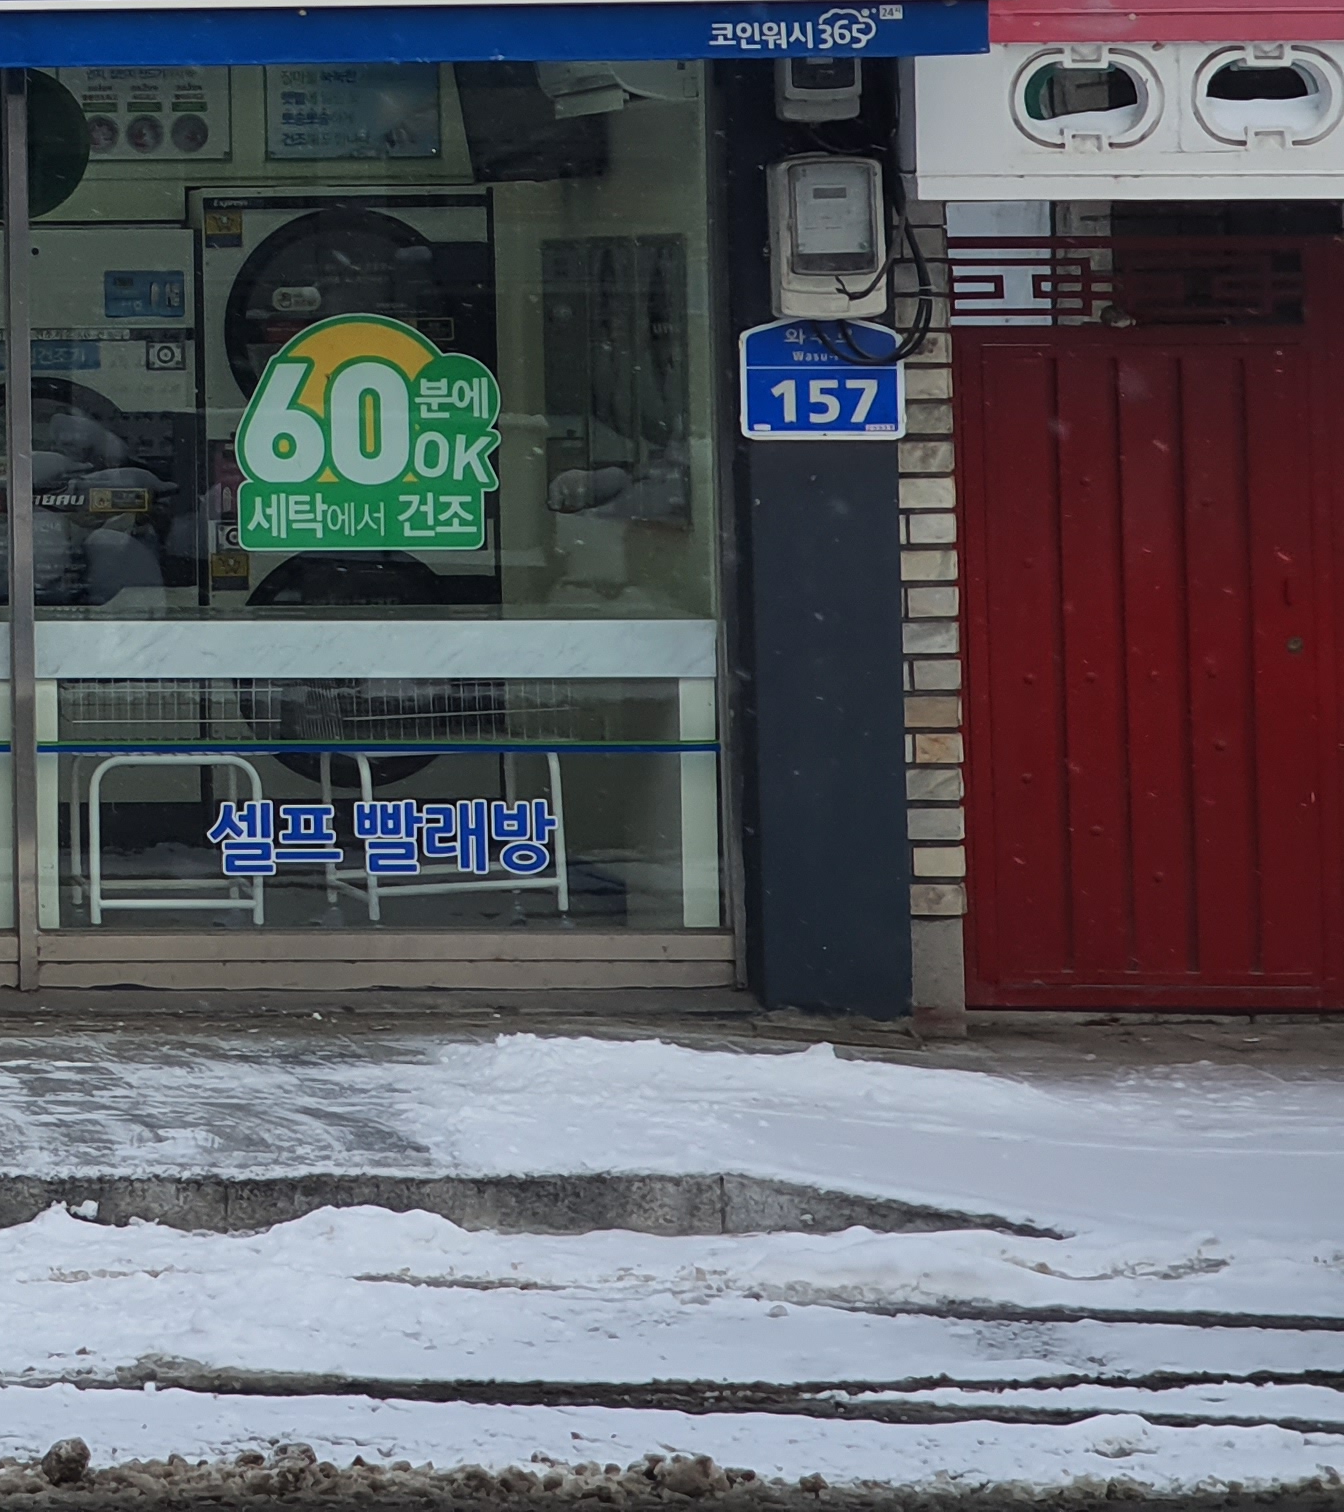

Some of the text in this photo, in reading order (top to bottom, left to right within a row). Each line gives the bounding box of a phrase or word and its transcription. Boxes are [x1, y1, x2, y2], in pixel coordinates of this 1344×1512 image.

[771, 379, 879, 424] 157
[414, 431, 493, 483] OK
[247, 492, 478, 538] 세탁에서 건조
[207, 799, 558, 876] 셀프 빨래방
